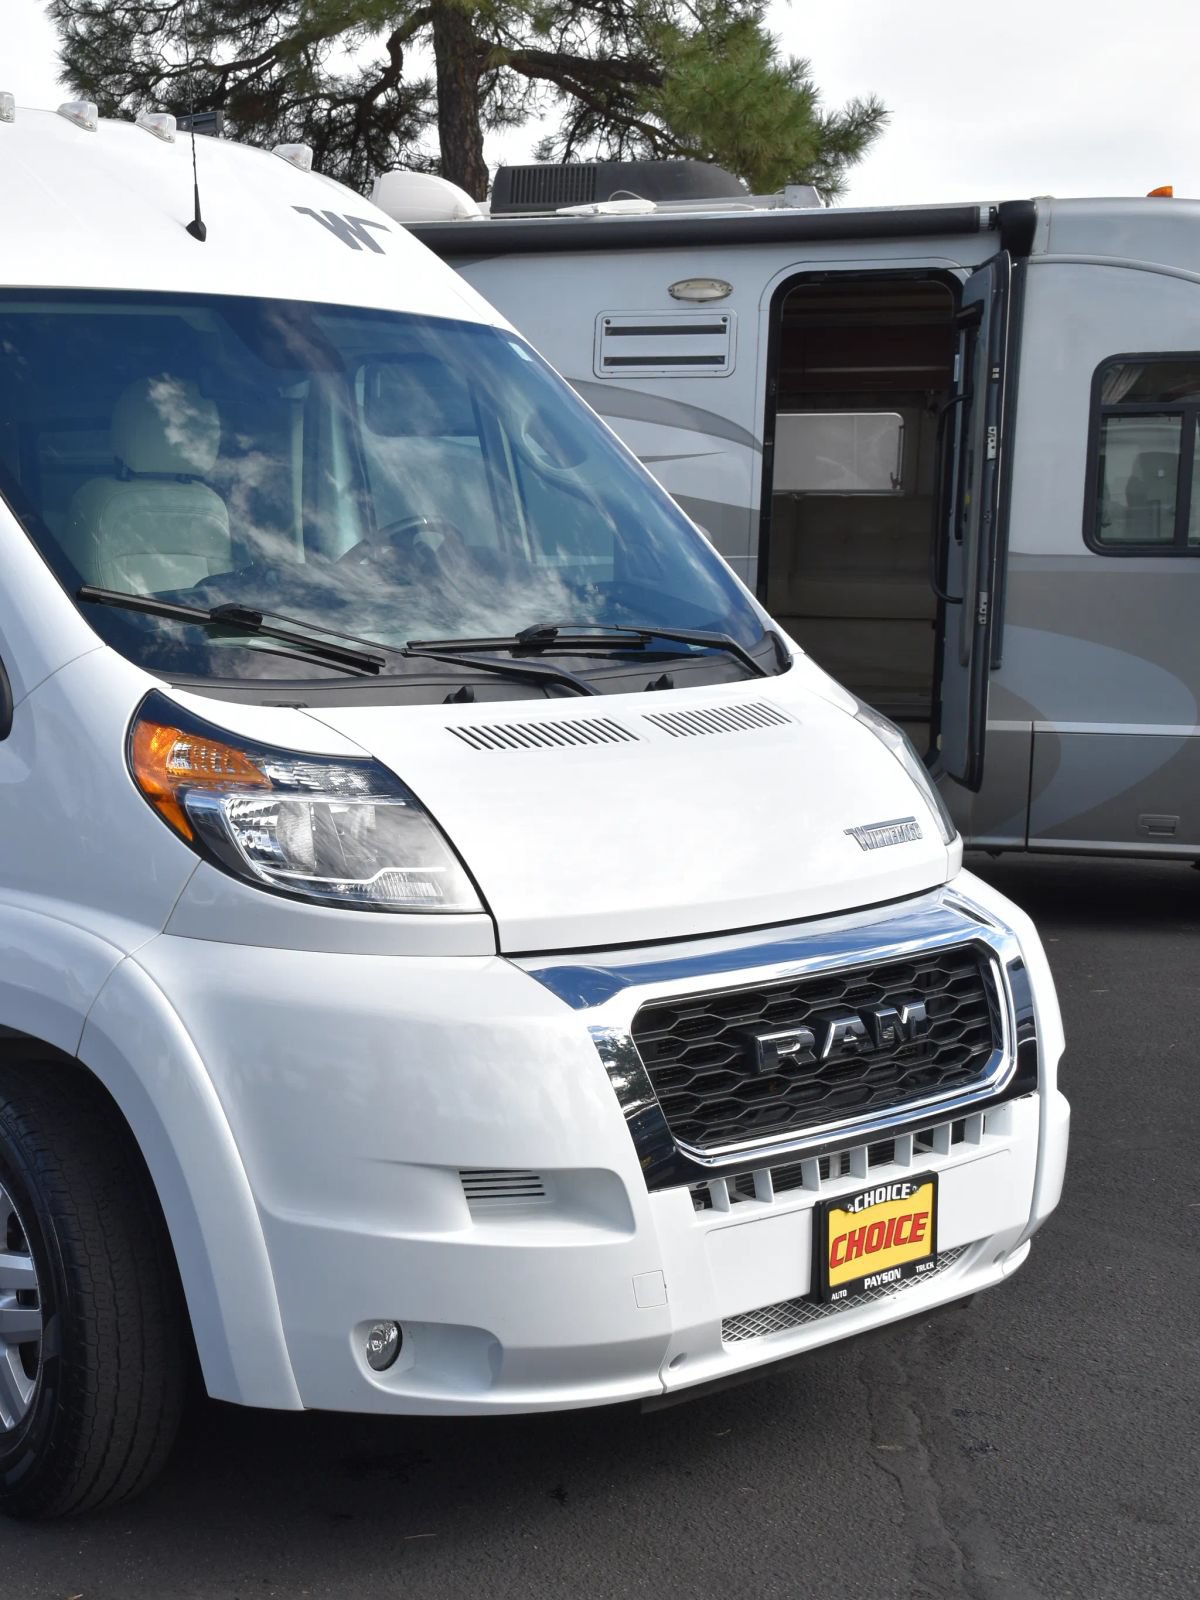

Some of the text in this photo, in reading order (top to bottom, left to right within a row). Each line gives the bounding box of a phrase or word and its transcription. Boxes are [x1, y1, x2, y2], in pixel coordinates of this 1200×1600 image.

[755, 1002, 927, 1072] RAM
[854, 1183, 911, 1213] CHOICE
[830, 1212, 929, 1269] CHOICE
[831, 1261, 935, 1301] AUTO PAYSON TRUCK
